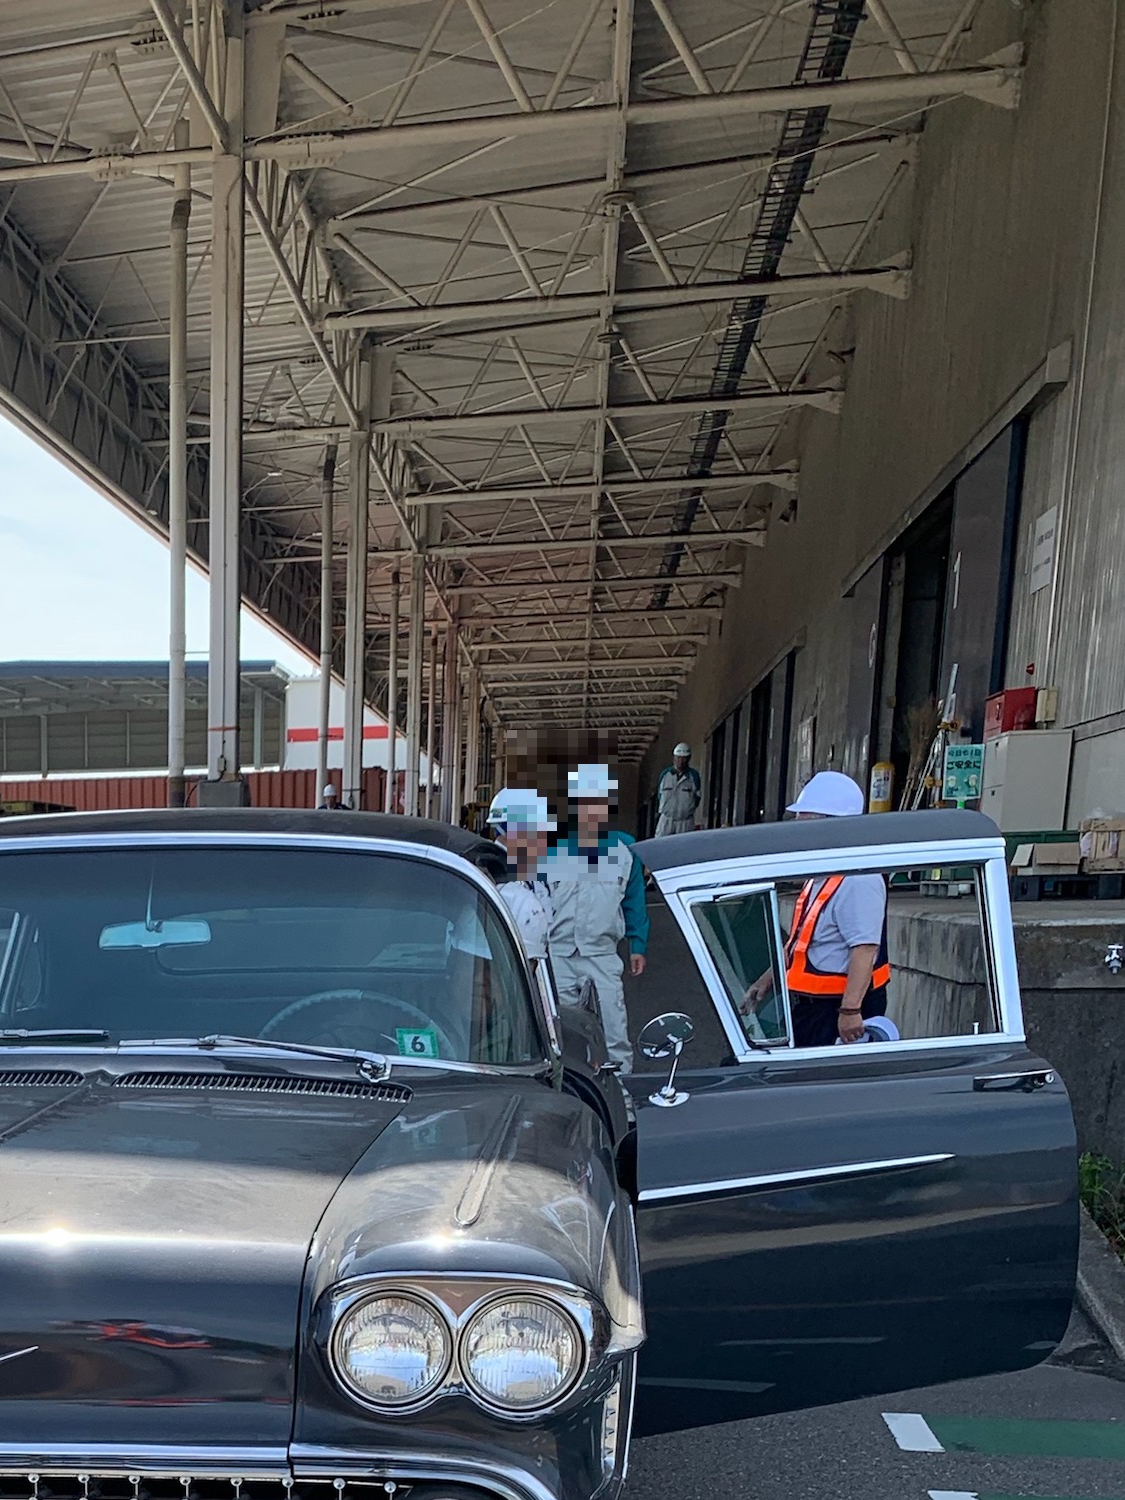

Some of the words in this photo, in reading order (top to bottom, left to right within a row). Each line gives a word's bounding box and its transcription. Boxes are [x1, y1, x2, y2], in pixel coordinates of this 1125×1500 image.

[946, 760, 981, 770] ご安全に
[411, 1035, 426, 1053] 6
